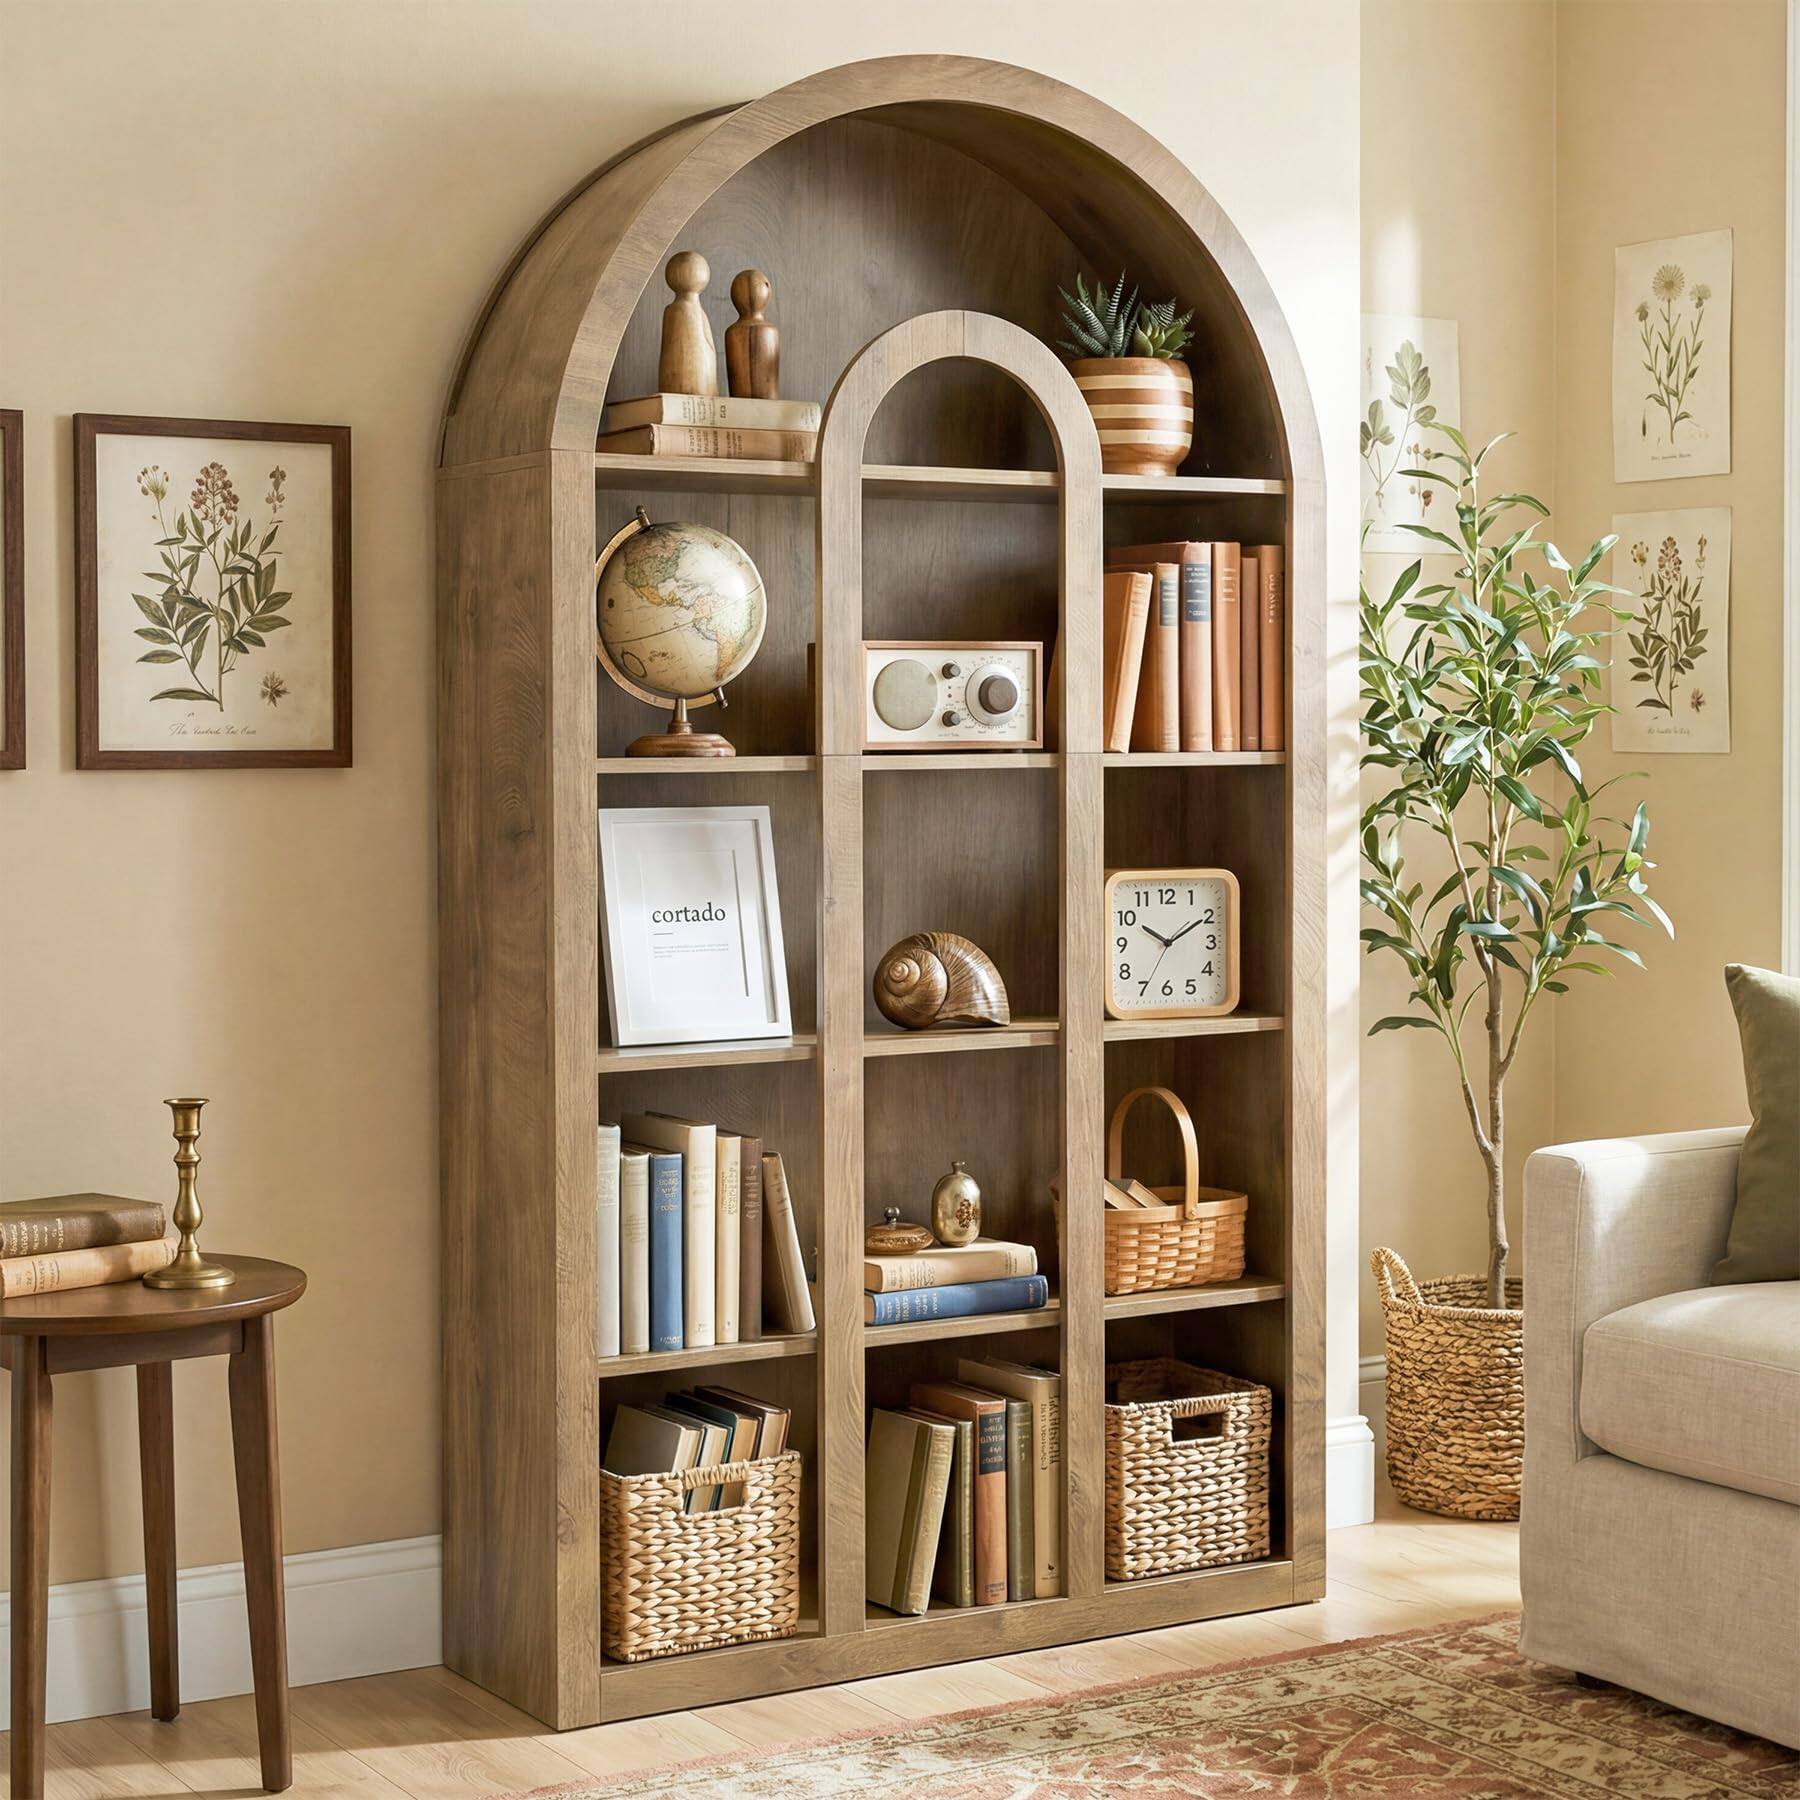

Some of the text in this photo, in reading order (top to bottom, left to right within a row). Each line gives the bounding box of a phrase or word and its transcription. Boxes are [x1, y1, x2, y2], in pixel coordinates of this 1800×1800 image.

[1134, 891, 1149, 907] 11
[1157, 888, 1176, 905] 12
[1187, 890, 1194, 906] 1
[652, 901, 726, 924] cortado
[1117, 910, 1136, 927] 10
[1203, 908, 1215, 924] 2
[1116, 936, 1128, 953] 9
[1205, 934, 1217, 950] 3
[1119, 963, 1131, 980] 8
[1201, 960, 1214, 976] 4
[1138, 980, 1149, 997] 7
[1161, 979, 1173, 996] 6
[1184, 979, 1197, 995] 5
